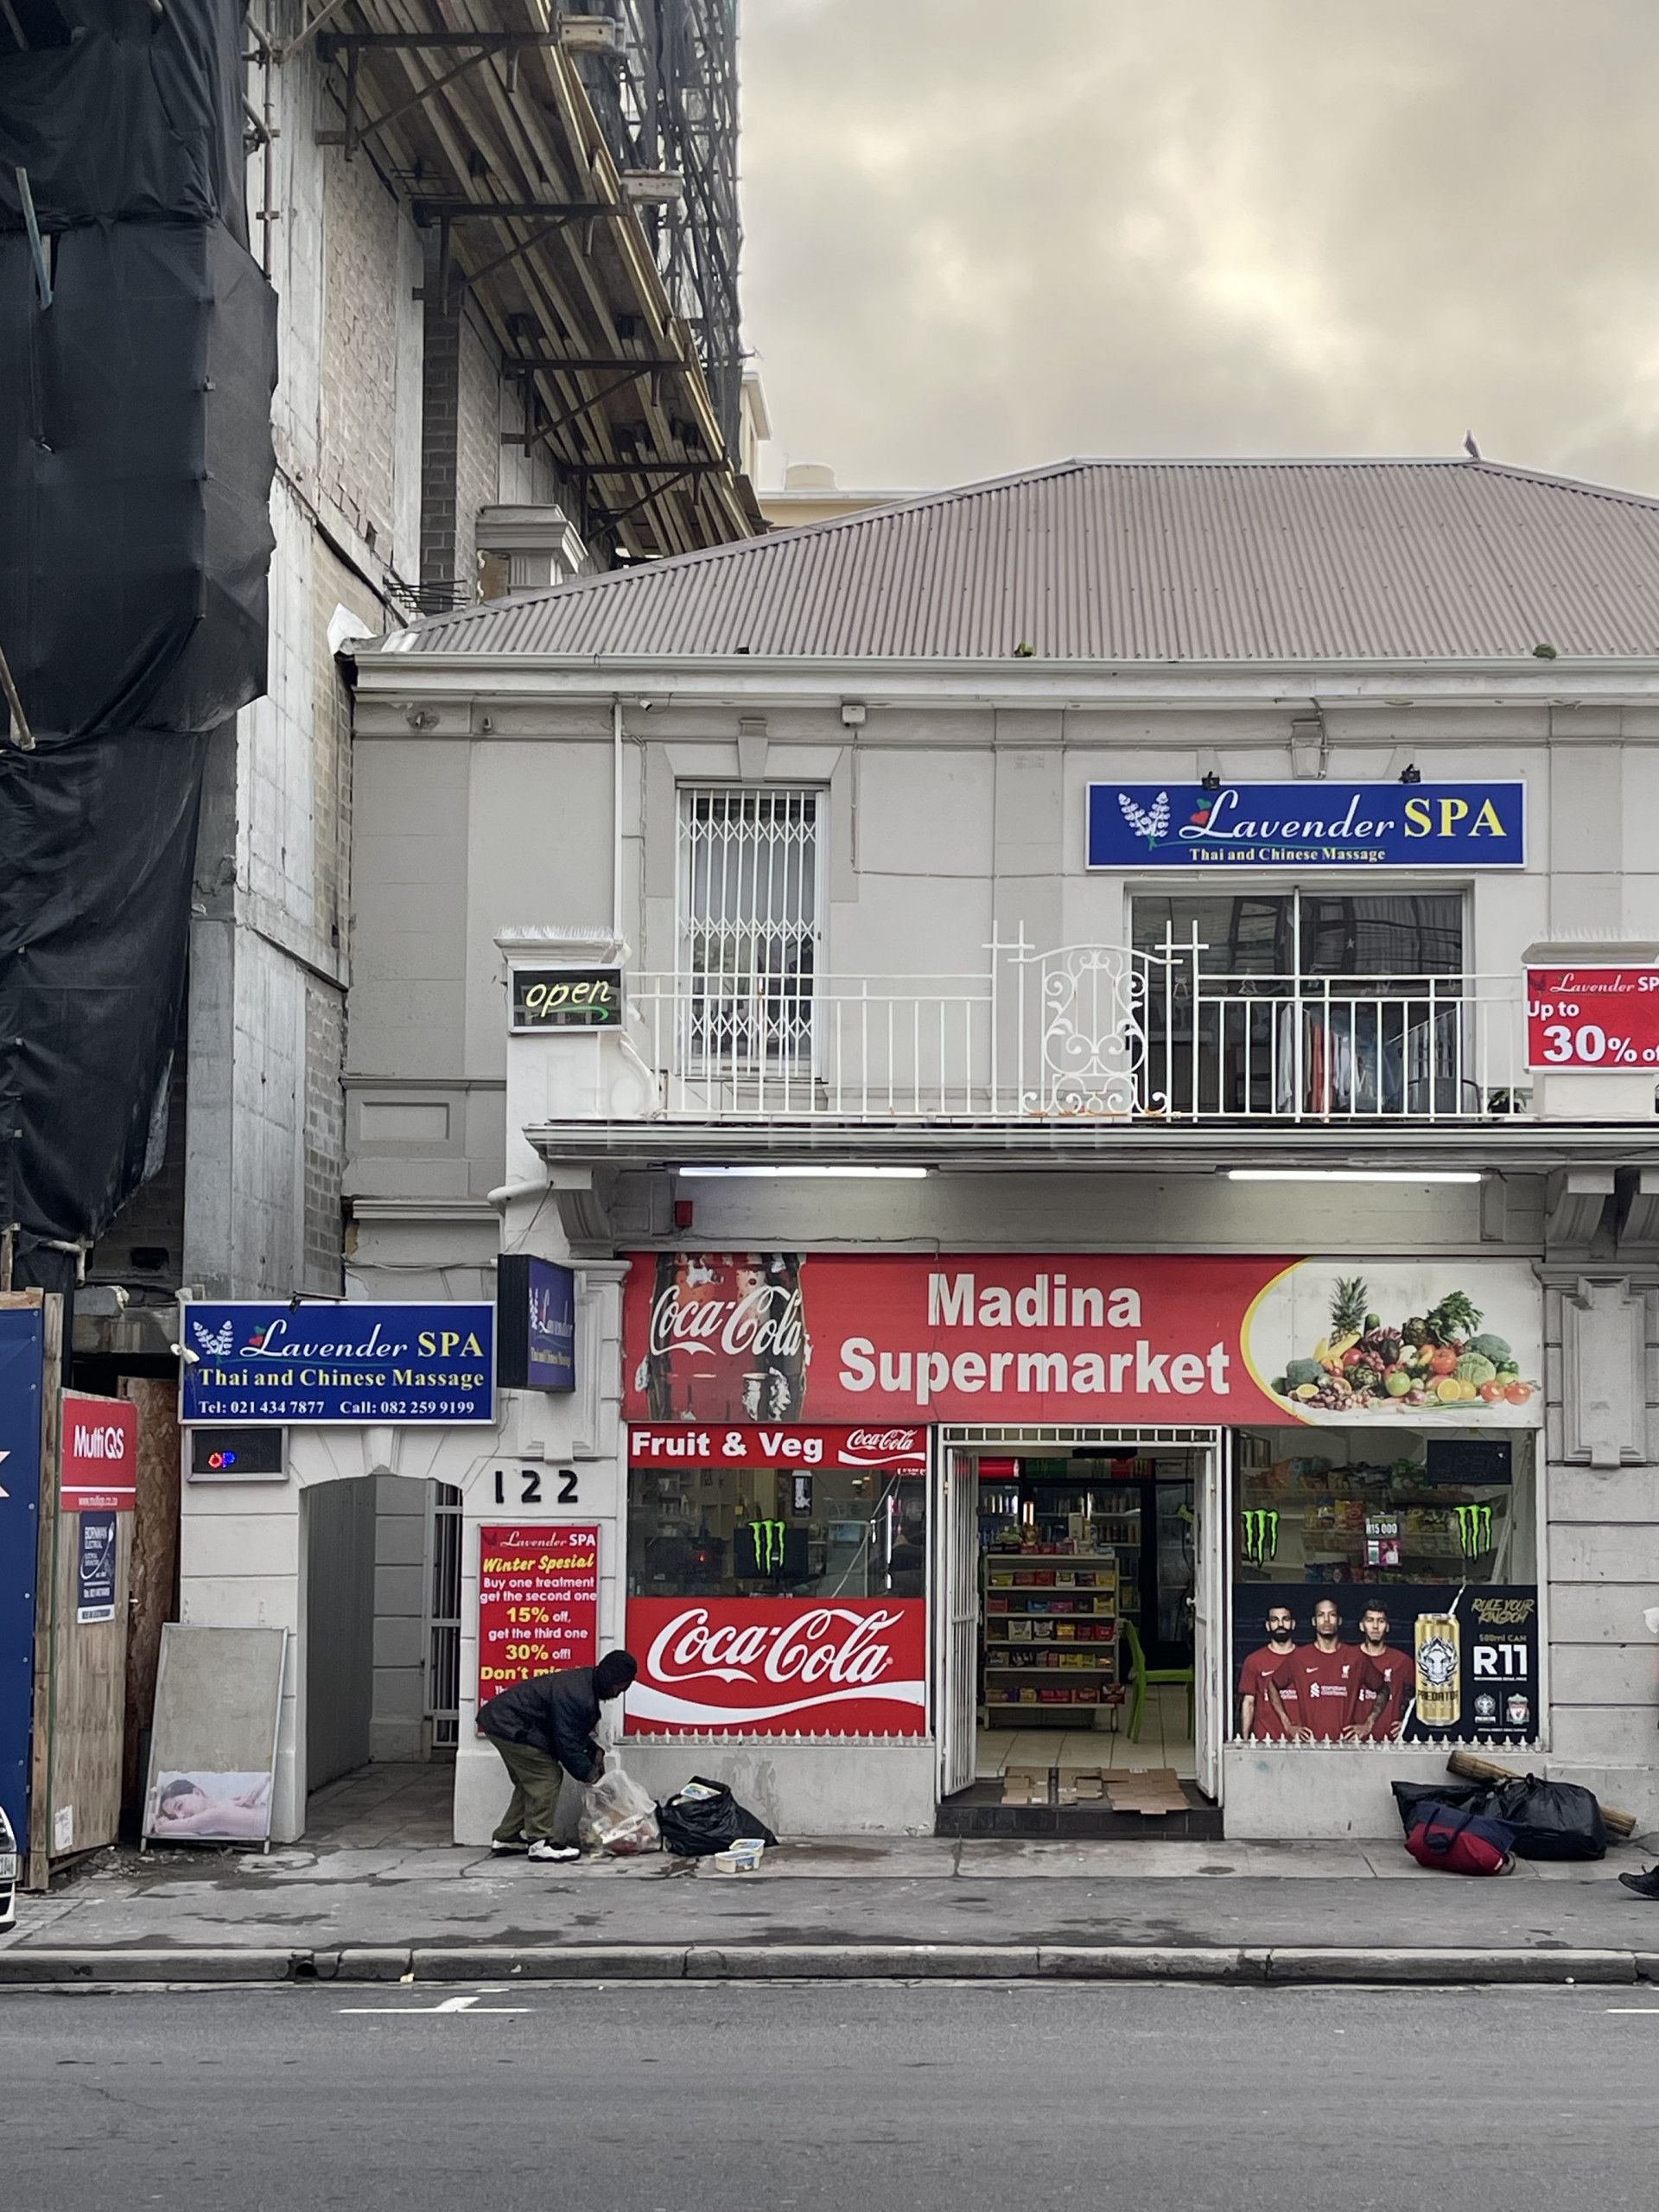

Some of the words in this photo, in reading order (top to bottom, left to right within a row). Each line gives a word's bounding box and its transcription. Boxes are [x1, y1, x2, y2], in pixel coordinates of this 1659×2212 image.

[1179, 789, 1395, 839] Lavender
[1404, 798, 1507, 837] SPA
[1189, 848, 1225, 861] Thai
[1228, 848, 1255, 861] and
[1259, 848, 1319, 861] Chinese
[1322, 848, 1386, 862] Massage
[1549, 972, 1636, 993] Lavender
[1637, 976, 1659, 992] SP
[525, 980, 612, 1018] open
[1528, 1000, 1554, 1021] Up
[1557, 1001, 1580, 1017] to
[1542, 1025, 1637, 1063] 30%
[927, 1273, 1141, 1327] Madina
[649, 1284, 803, 1356] Coca-Cola
[239, 1319, 408, 1358] Lavender
[416, 1332, 485, 1357] SPA
[198, 1368, 249, 1387] Thai
[253, 1368, 294, 1387] and
[299, 1368, 386, 1387] Chinese
[391, 1369, 485, 1390] Massage
[838, 1337, 1230, 1405] Supermarket
[198, 1401, 228, 1414] Tel:
[230, 1402, 256, 1414] 021
[259, 1402, 287, 1414] 434
[290, 1402, 326, 1414] 7877
[340, 1401, 377, 1414] Call:
[380, 1402, 407, 1414] 082
[410, 1402, 436, 1414] 259
[439, 1402, 475, 1414] 9199
[632, 1431, 710, 1457] Fruit
[721, 1431, 747, 1457] &
[759, 1432, 823, 1462] Veg
[847, 1428, 918, 1451] Coca-Cola
[499, 1530, 567, 1548] Lavender
[569, 1533, 596, 1547] SPA
[483, 1557, 537, 1573] Winter
[484, 1577, 506, 1591] Buy
[508, 1579, 533, 1588] one
[536, 1577, 594, 1588] treatment
[480, 1591, 500, 1605] get
[503, 1590, 524, 1601] the
[525, 1590, 571, 1601] second
[574, 1592, 598, 1601] one
[1471, 1598, 1503, 1612] RULE
[1504, 1598, 1535, 1613] YOUR
[506, 1606, 550, 1624] 15%
[1478, 1611, 1529, 1625] KINGDOM
[488, 1628, 509, 1642] get
[512, 1628, 531, 1639] the
[534, 1627, 562, 1639] third
[564, 1629, 588, 1639] one
[505, 1643, 549, 1661] 30%
[647, 1608, 905, 1683] Coca-Cola
[1473, 1643, 1528, 1675] R11
[480, 1666, 529, 1681] Don't
